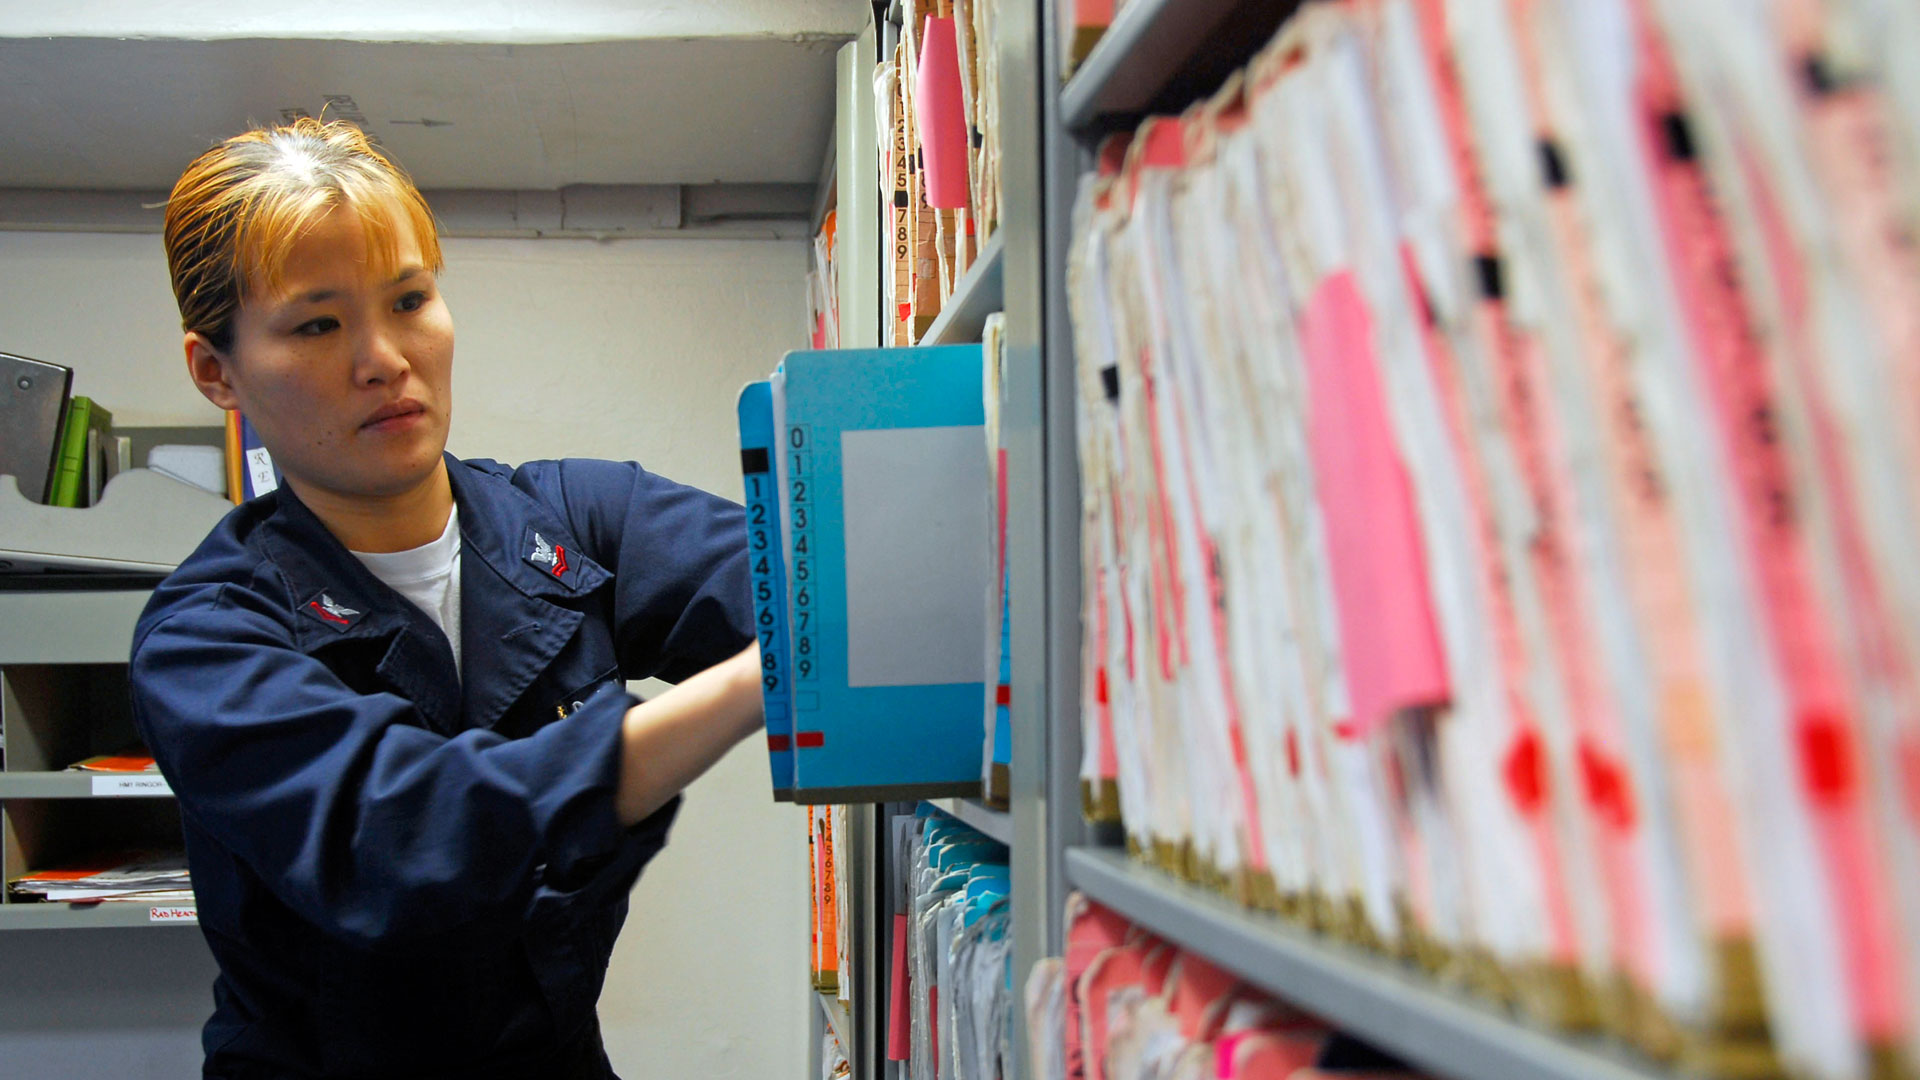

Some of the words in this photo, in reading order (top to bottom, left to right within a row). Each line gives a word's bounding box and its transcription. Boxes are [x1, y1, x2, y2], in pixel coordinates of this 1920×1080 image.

[897, 118, 905, 133] 2
[897, 136, 906, 151] 3
[897, 154, 906, 169] 4
[897, 173, 907, 187] 5
[898, 208, 907, 223] 7
[897, 226, 907, 241] 8
[897, 244, 907, 259] 9
[791, 427, 804, 449] 0
[794, 454, 801, 475] 1
[752, 477, 760, 498] 1
[793, 481, 806, 502] 2
[751, 504, 766, 525] 2
[795, 508, 807, 529] 3
[753, 530, 768, 551] 3
[795, 534, 808, 555] 4
[755, 556, 769, 575] 4
[797, 560, 809, 581] 5
[757, 581, 772, 601] 5
[798, 586, 810, 607] 6
[759, 606, 774, 626] 6
[799, 611, 809, 632] 7
[761, 630, 774, 649] 7
[798, 636, 811, 655] 8
[764, 653, 777, 671] 8
[798, 659, 811, 678] 9
[764, 675, 778, 692] 9
[825, 845, 832, 855] 5
[825, 857, 832, 868] 6
[825, 869, 832, 880] 7
[824, 883, 831, 894] 8
[824, 895, 831, 905] 9
